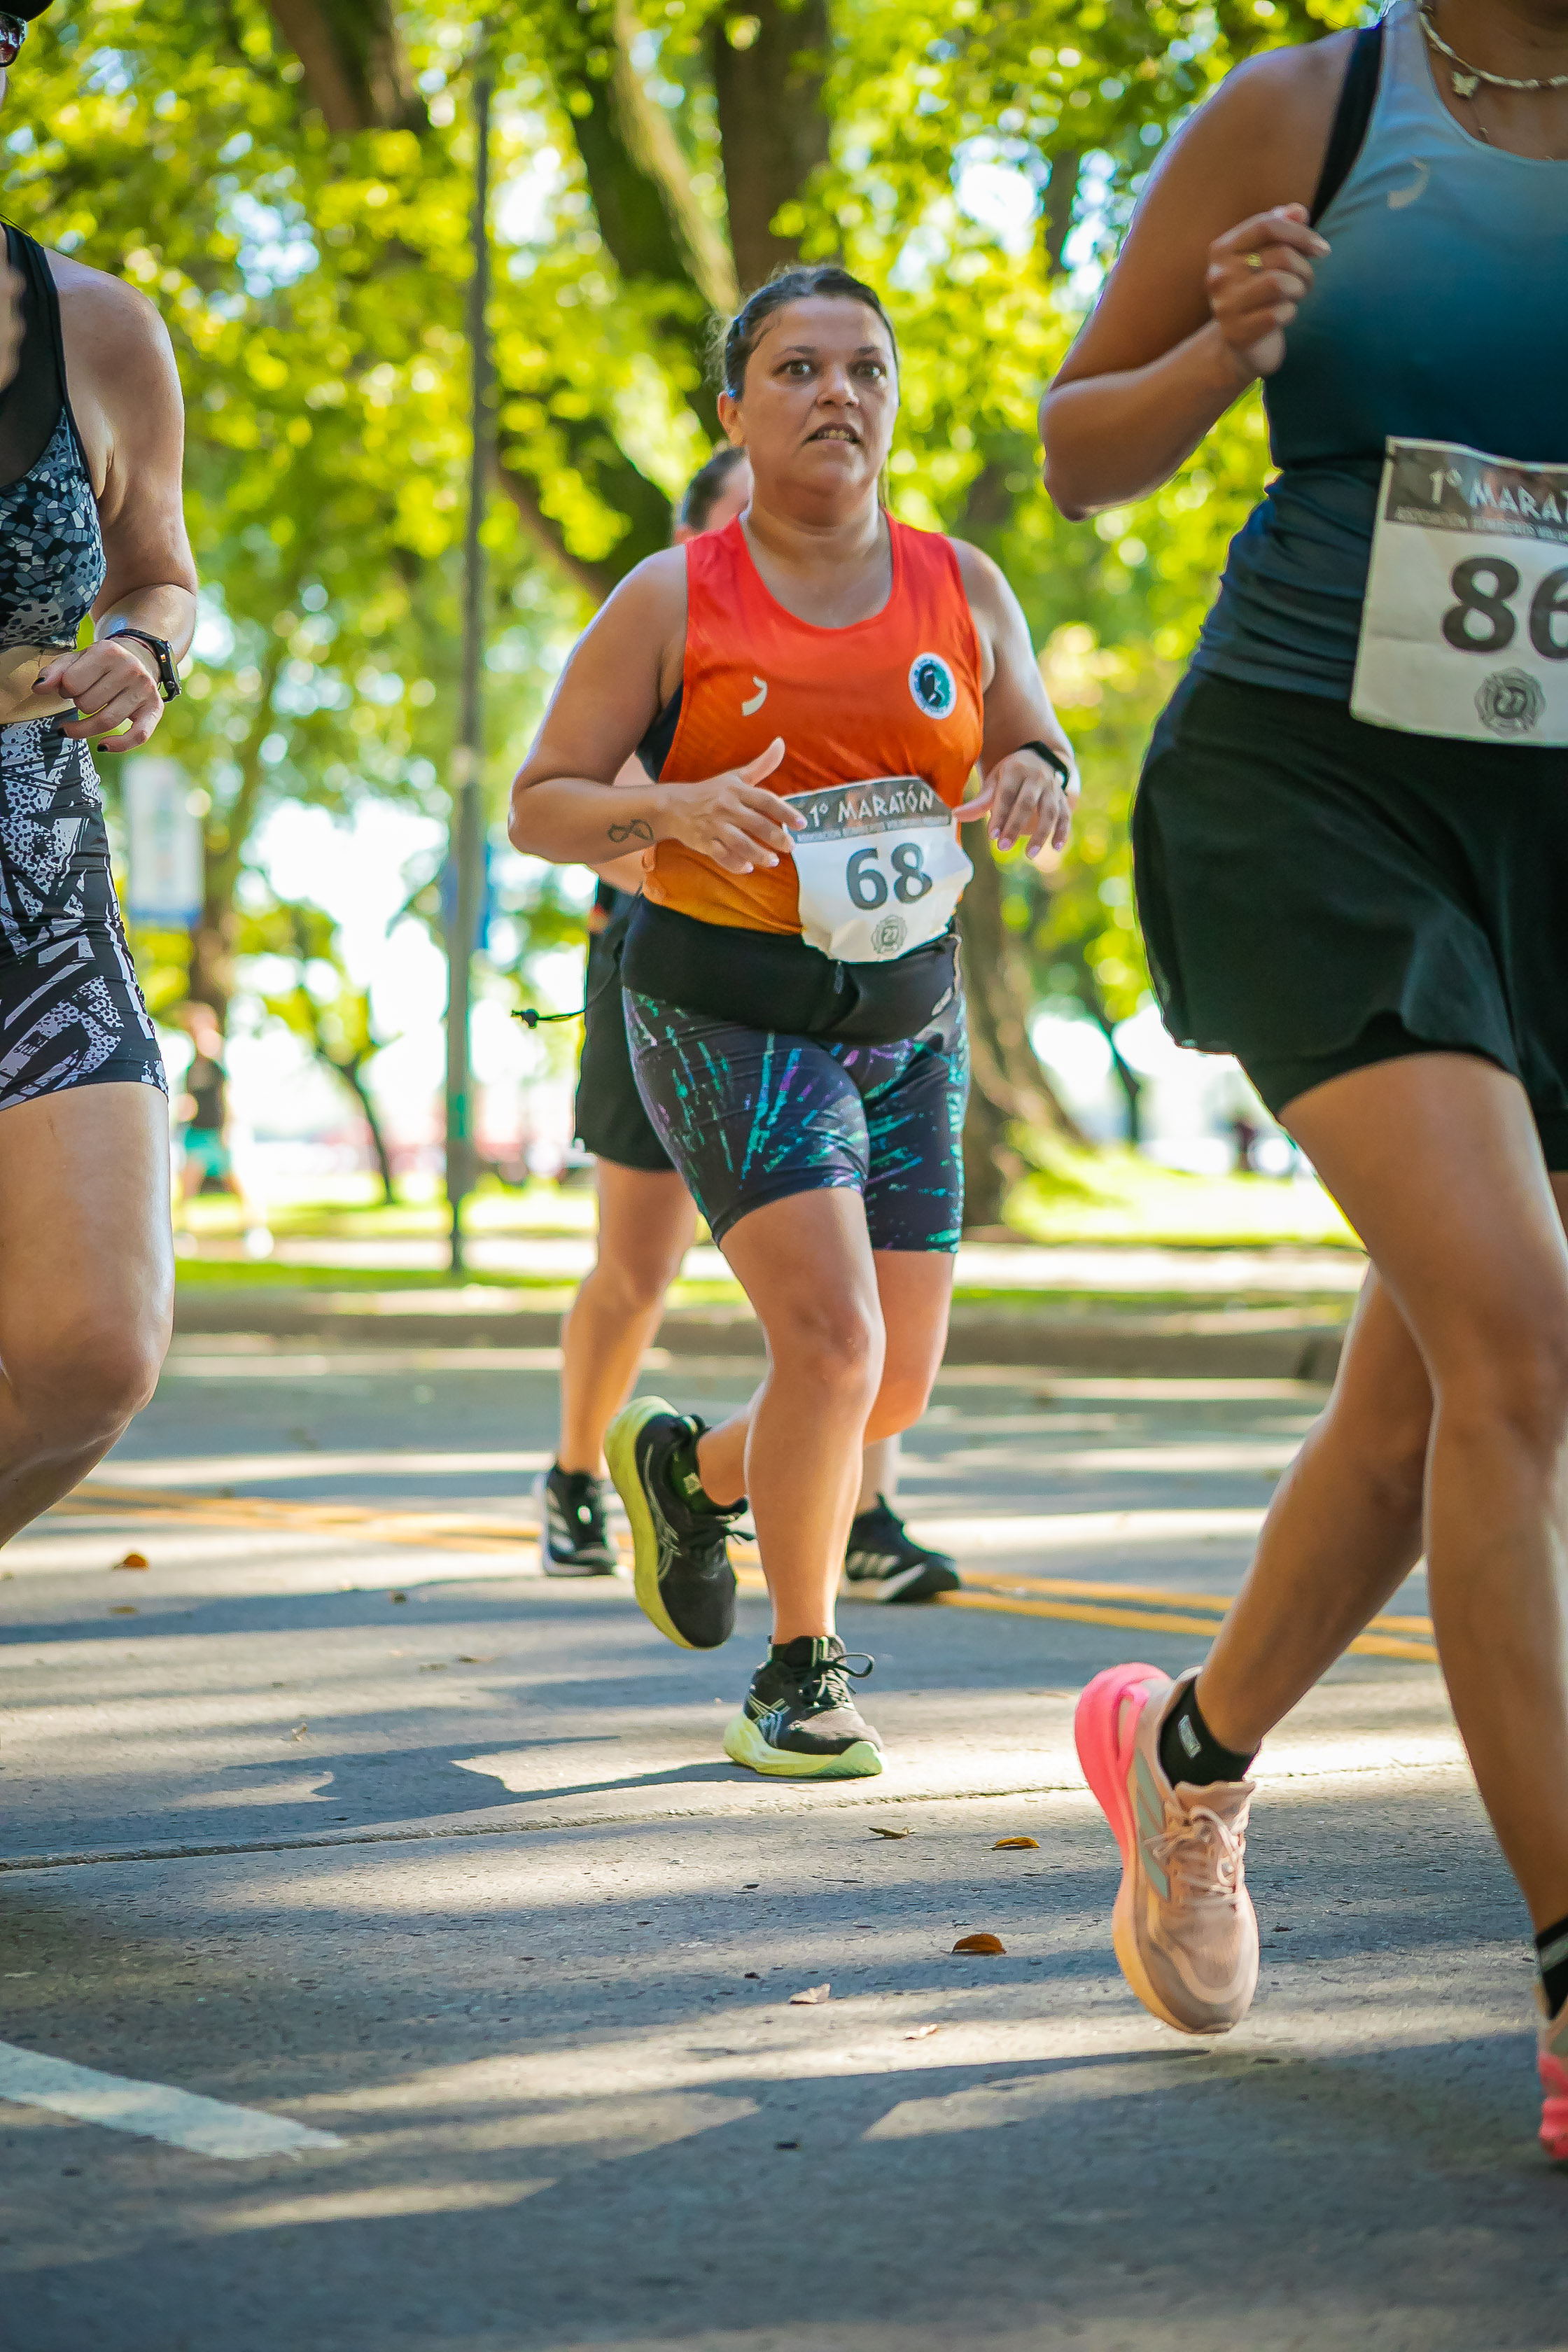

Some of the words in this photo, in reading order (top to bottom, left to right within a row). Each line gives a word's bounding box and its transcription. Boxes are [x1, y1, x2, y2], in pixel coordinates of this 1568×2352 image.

[1441, 555, 1568, 659] 86
[838, 784, 934, 822] MARATÓN
[846, 843, 932, 910] 68
